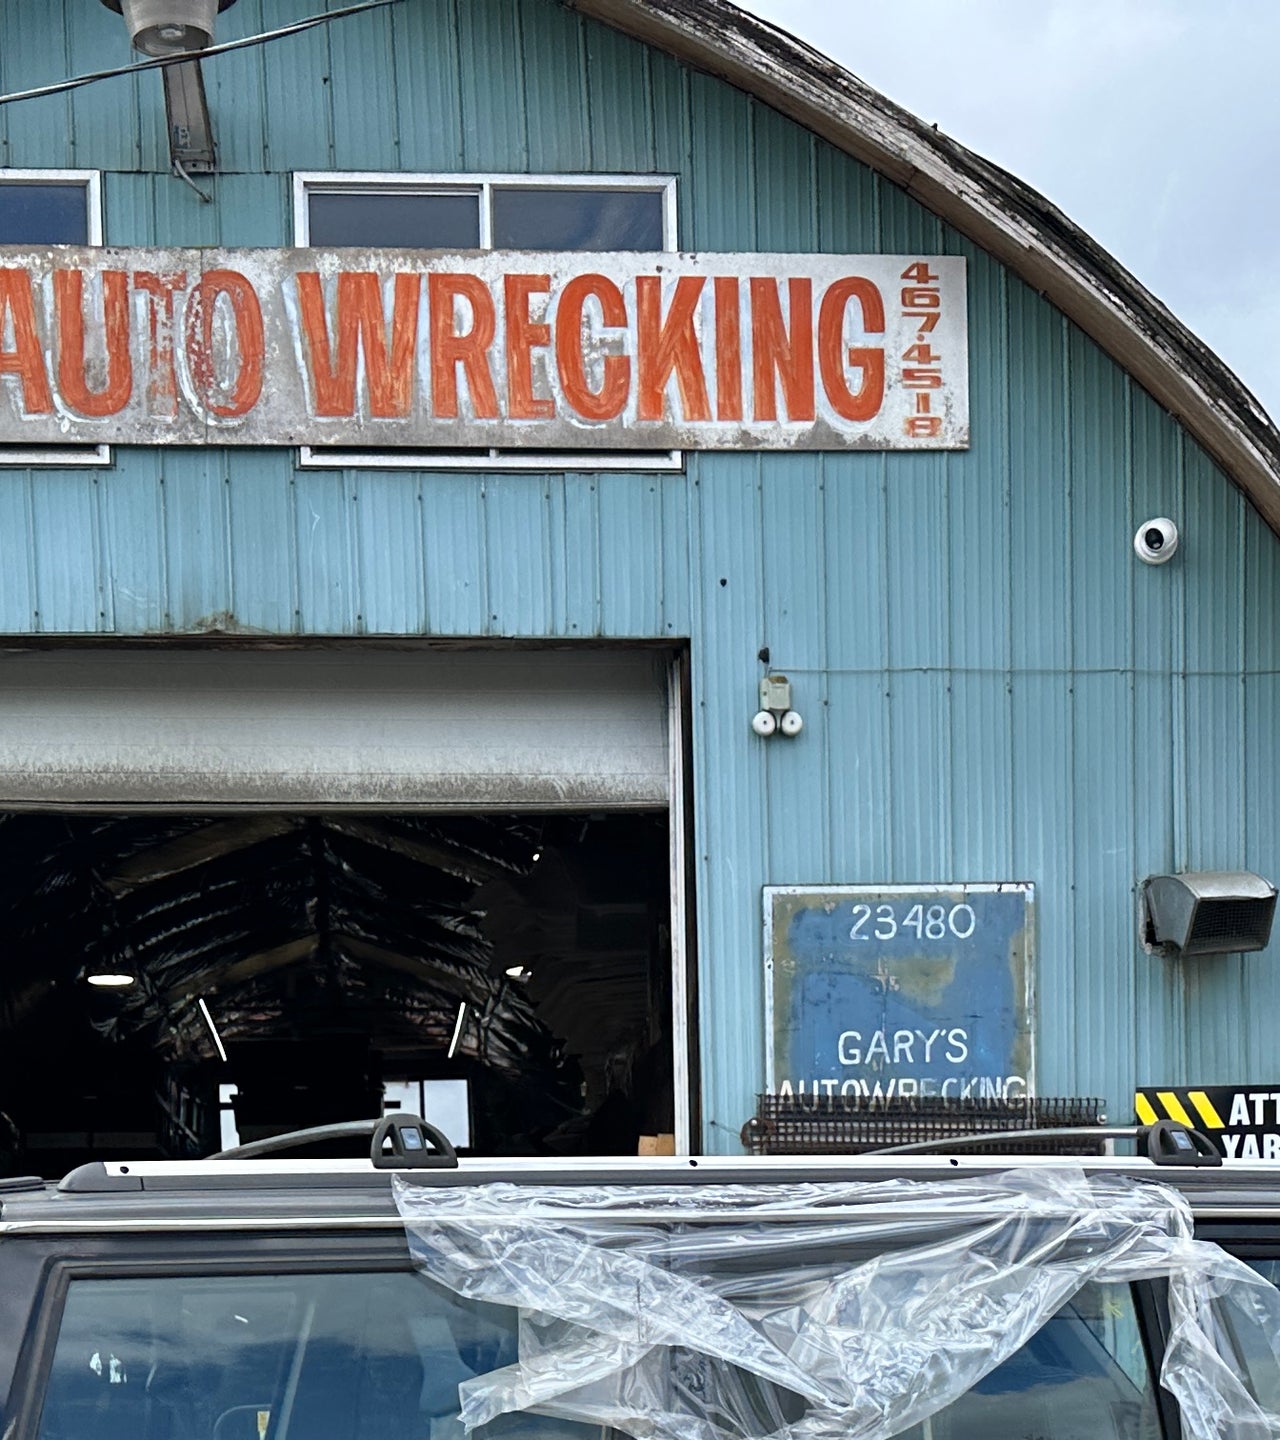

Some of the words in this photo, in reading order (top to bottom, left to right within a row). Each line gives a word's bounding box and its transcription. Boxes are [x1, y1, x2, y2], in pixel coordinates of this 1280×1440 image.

[295, 270, 886, 424] WRECKING
[849, 903, 976, 940] 23480
[837, 1028, 969, 1066] GARY'S
